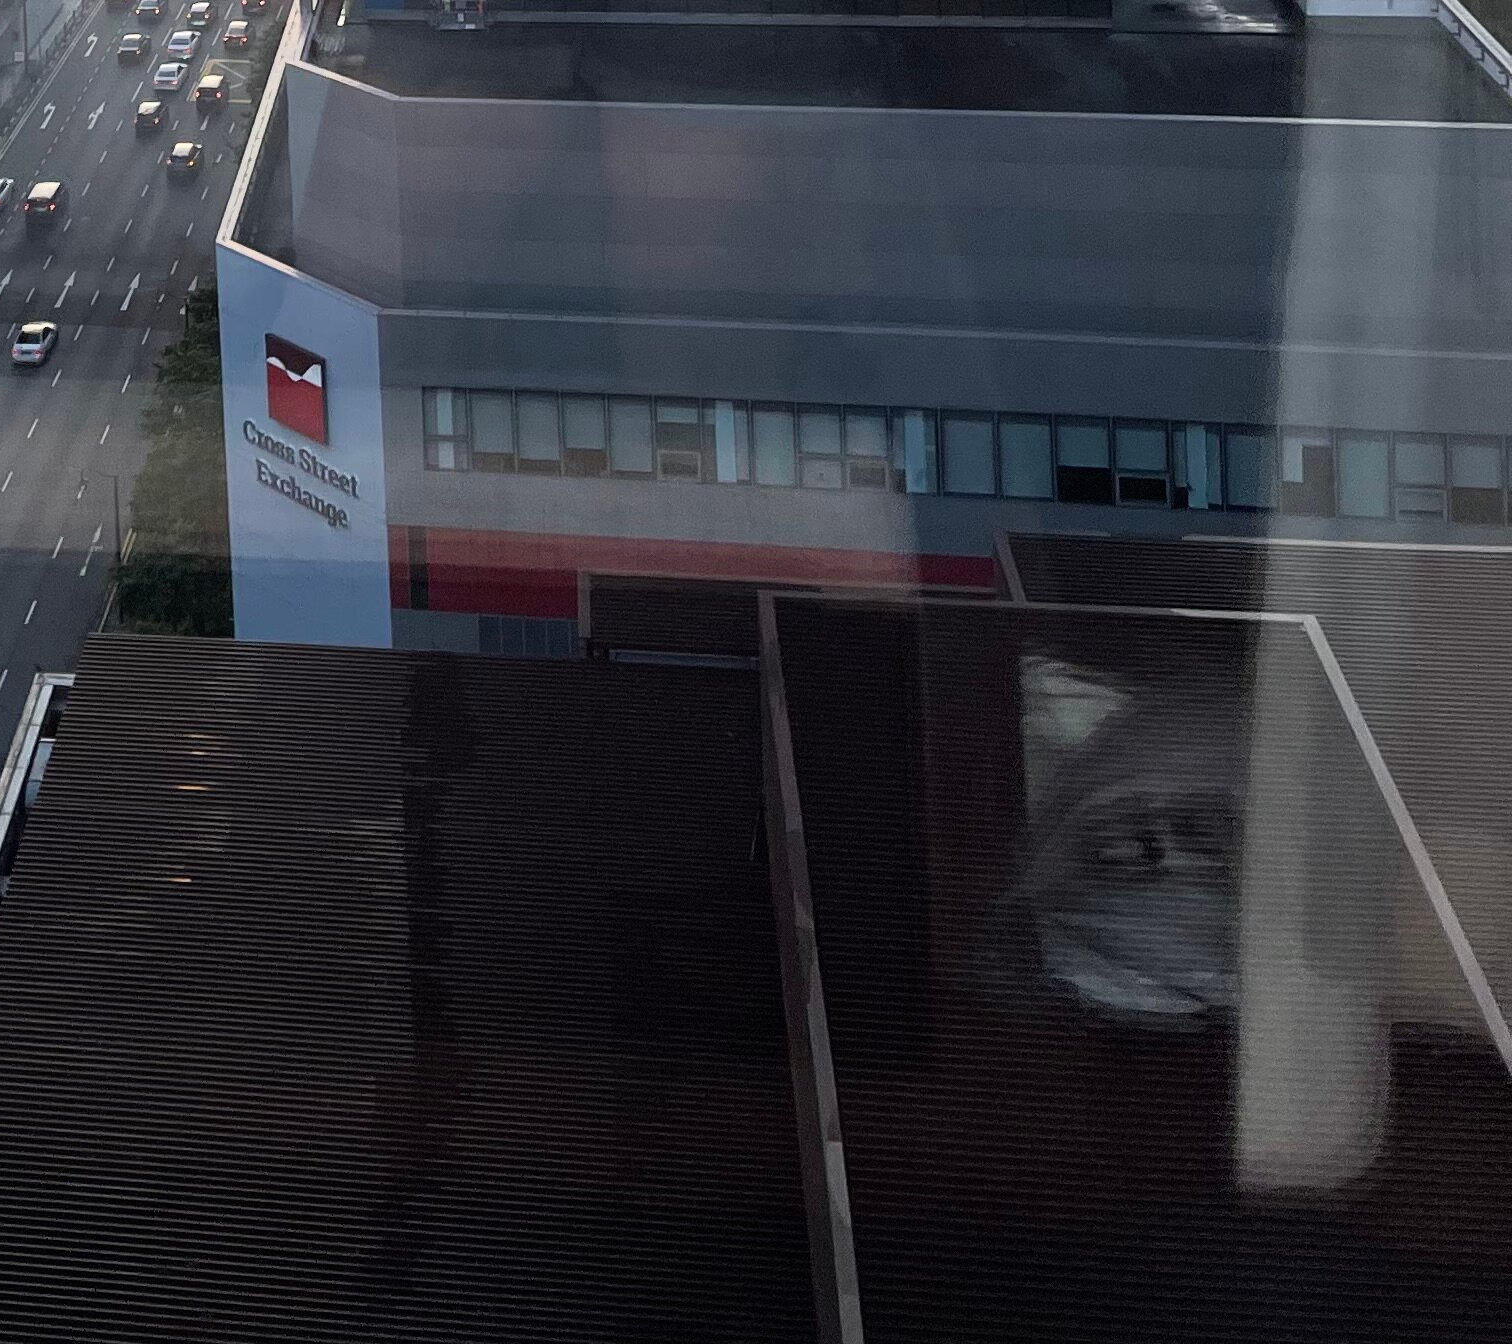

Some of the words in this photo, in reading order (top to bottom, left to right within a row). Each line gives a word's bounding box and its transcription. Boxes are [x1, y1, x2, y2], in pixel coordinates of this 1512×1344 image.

[243, 419, 295, 464] Cross
[298, 448, 360, 499] Street
[255, 458, 350, 529] Exchange
